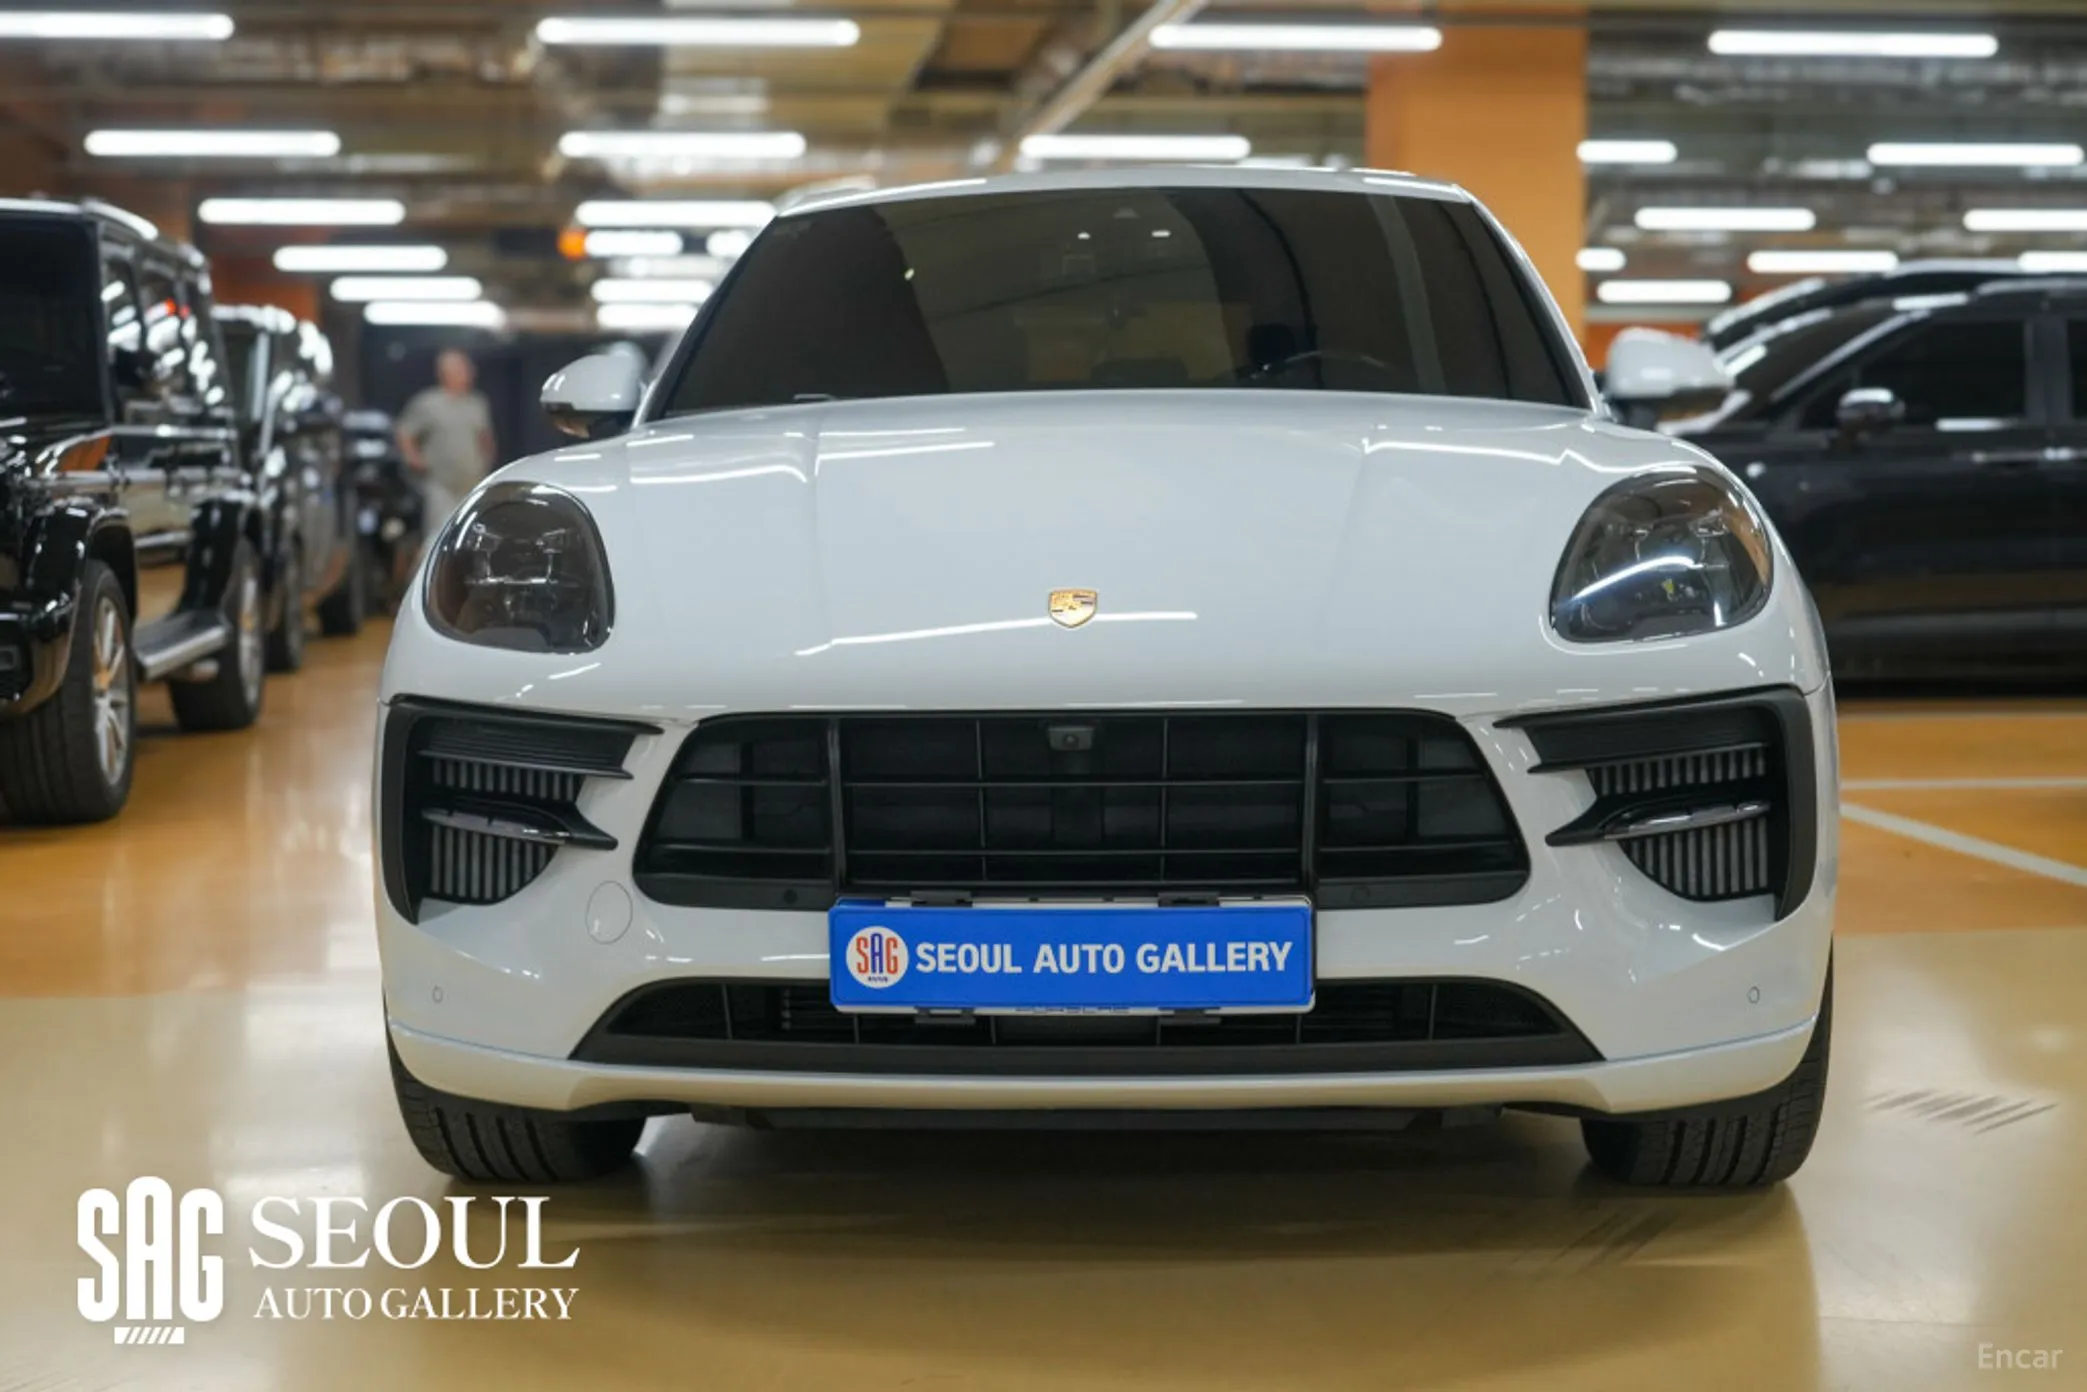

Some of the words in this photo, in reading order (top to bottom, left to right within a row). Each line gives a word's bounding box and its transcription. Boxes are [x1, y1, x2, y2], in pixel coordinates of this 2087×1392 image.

[856, 932, 898, 974] SAG
[915, 942, 1023, 974] SEOUL
[1033, 943, 1125, 974] AUTO
[1136, 941, 1293, 974] GALLERY
